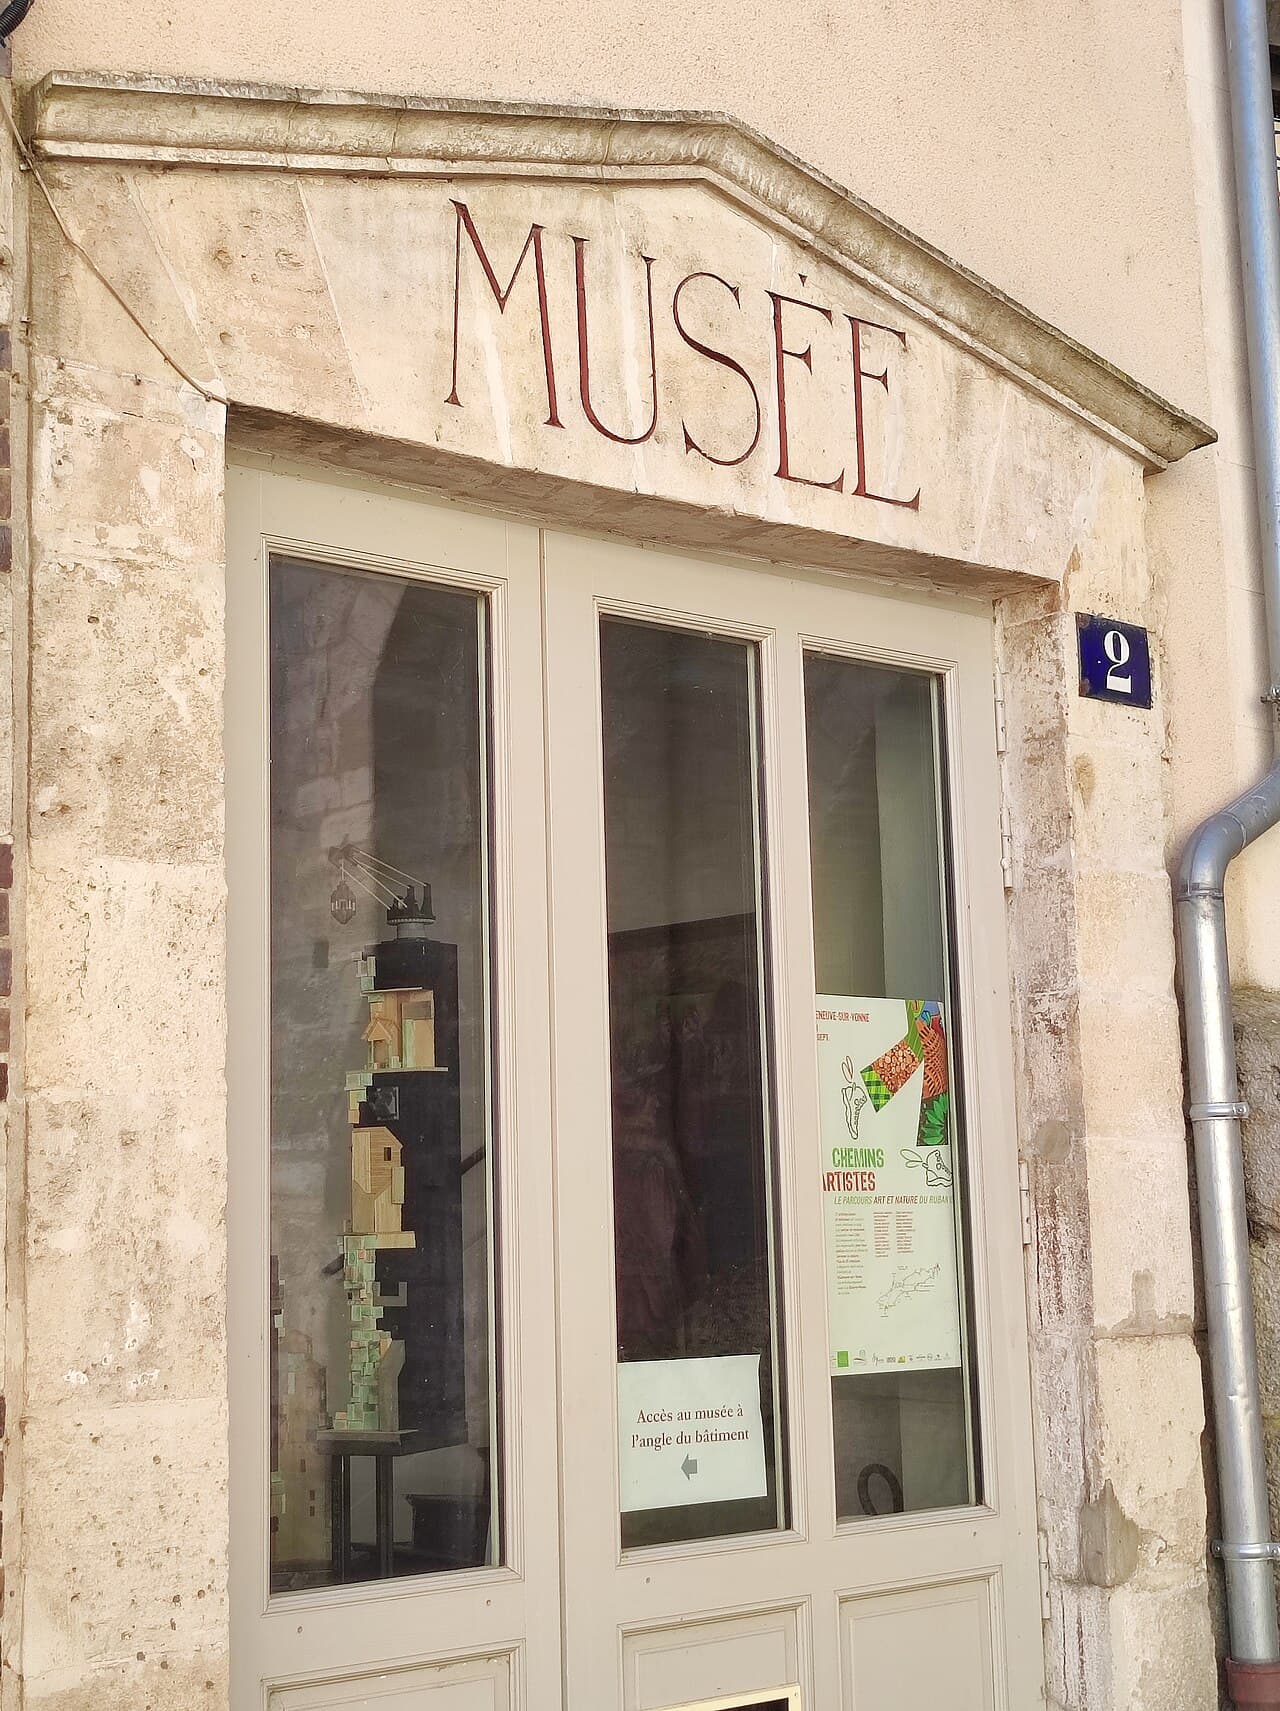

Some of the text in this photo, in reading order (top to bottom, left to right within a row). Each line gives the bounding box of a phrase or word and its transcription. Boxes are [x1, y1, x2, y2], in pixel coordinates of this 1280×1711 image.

[444, 198, 921, 512] MUSÉE
[1104, 631, 1132, 694] 2
[832, 1147, 884, 1168] CHEMINS
[842, 1195, 873, 1206] PARCOURS
[873, 1195, 886, 1205] ART
[886, 1195, 894, 1205] ET
[895, 1195, 918, 1205] NATURE
[637, 1403, 744, 1424] Accès au musée à
[631, 1429, 750, 1451] l'angle du bâtiment
